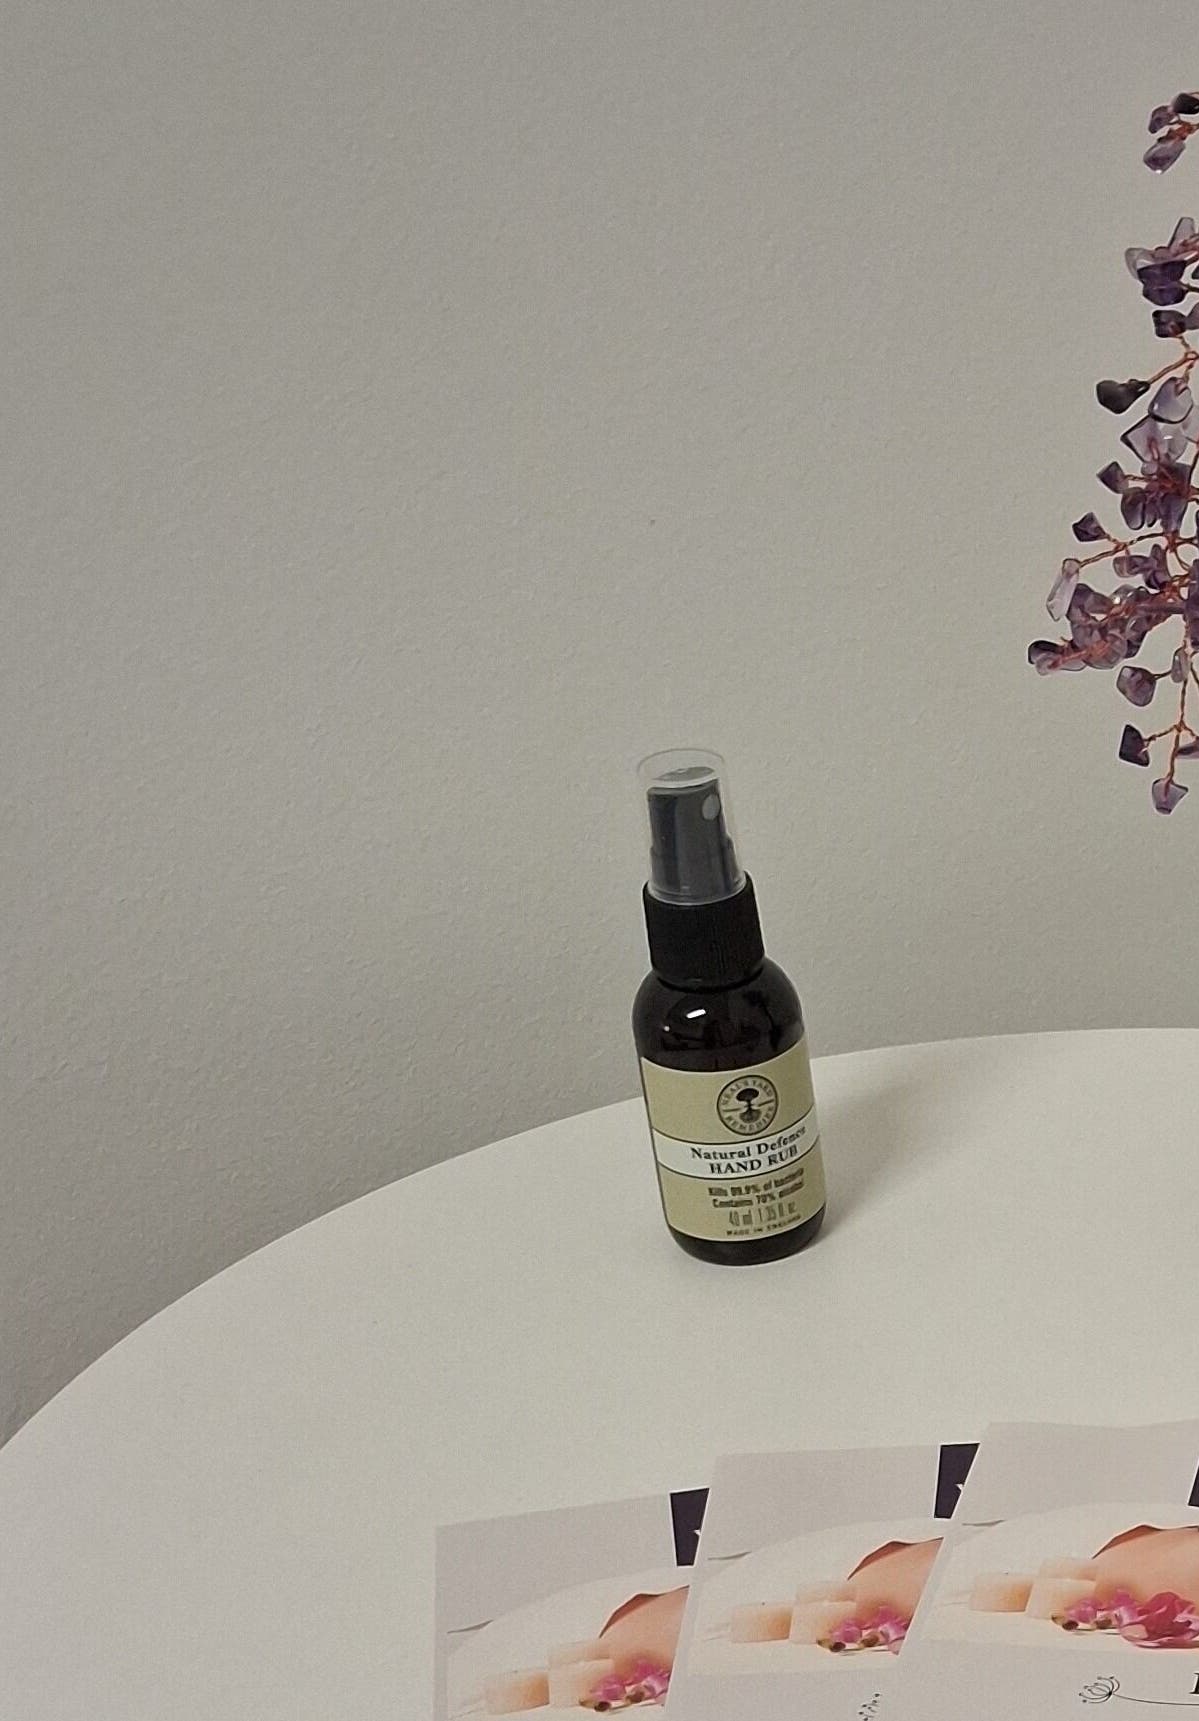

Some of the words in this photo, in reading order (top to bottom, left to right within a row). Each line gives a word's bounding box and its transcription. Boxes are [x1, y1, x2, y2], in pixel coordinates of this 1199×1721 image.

[690, 1146, 751, 1160] Natural
[709, 1159, 762, 1174] HAND
[768, 1144, 799, 1166] RUB
